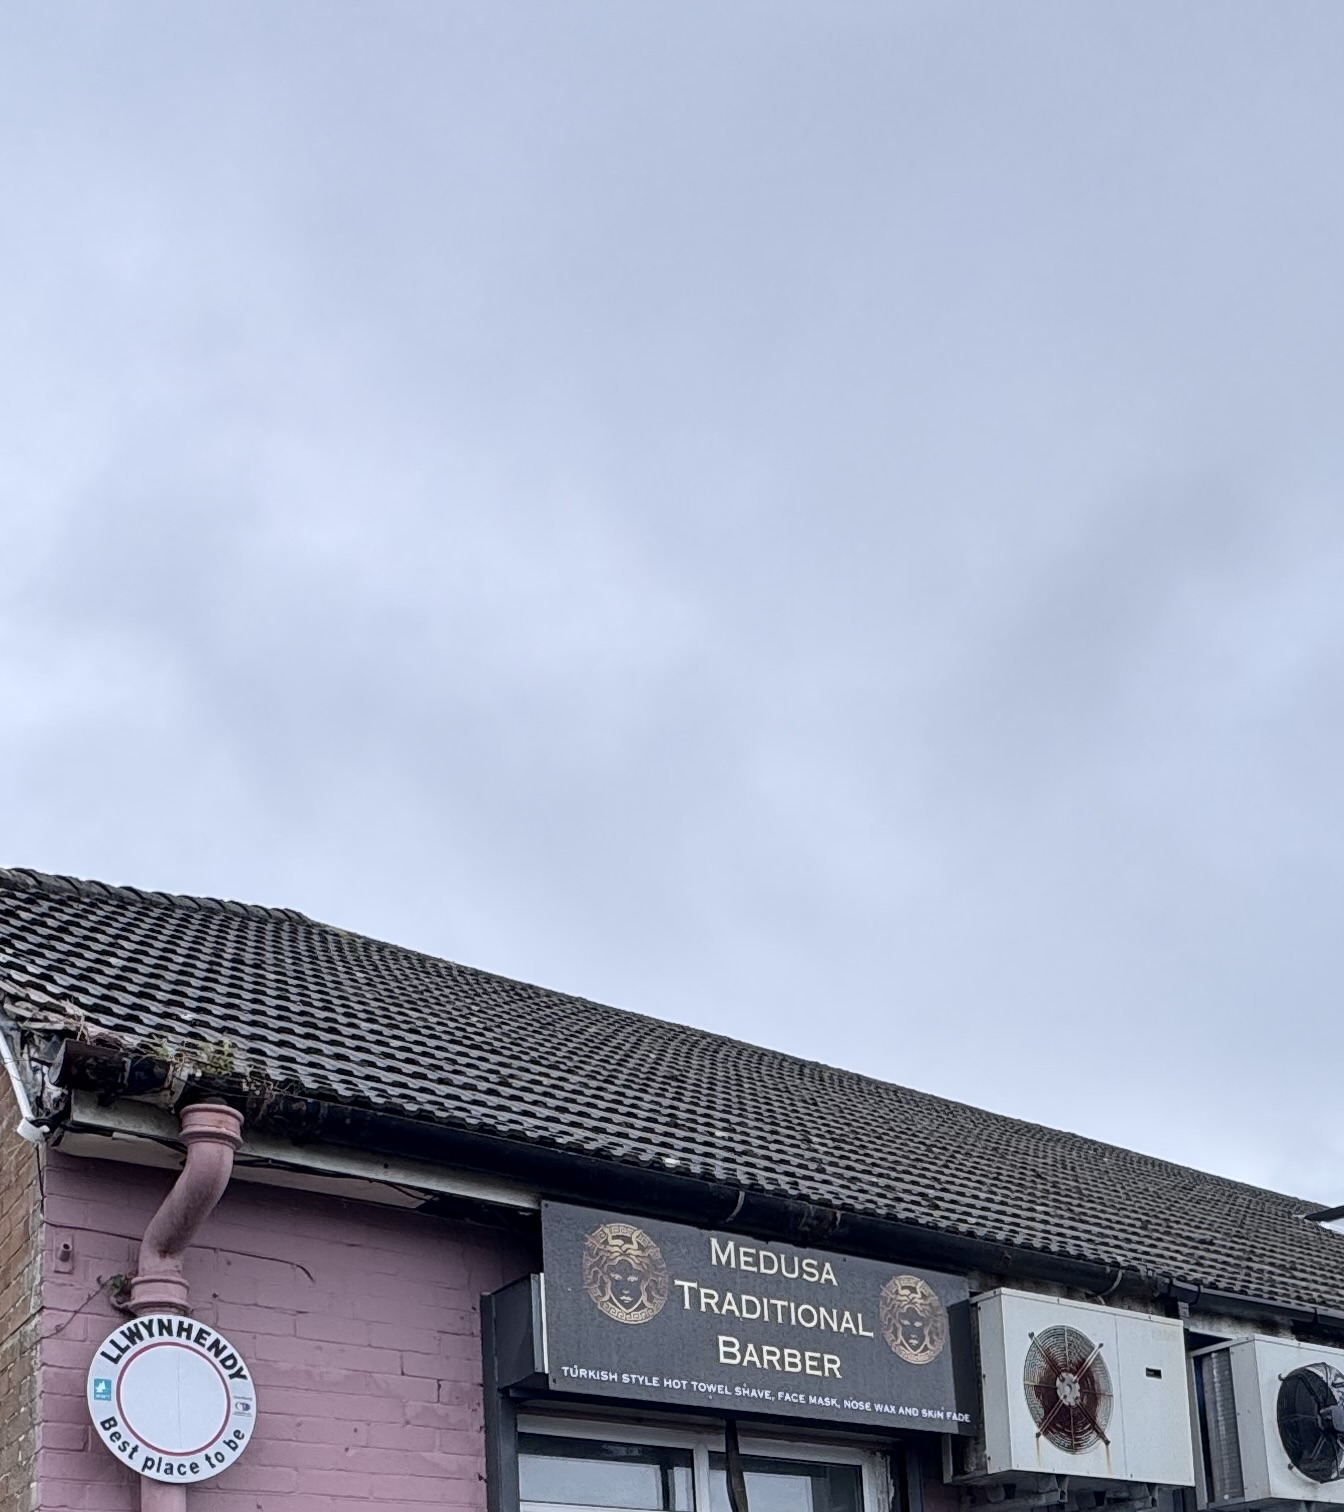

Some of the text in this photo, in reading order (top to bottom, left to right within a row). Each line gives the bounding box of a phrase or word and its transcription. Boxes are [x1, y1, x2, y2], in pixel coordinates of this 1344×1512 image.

[710, 1237, 837, 1286] MEDUSA
[674, 1279, 874, 1339] TRADITIONAL
[100, 1318, 248, 1381] LLWYNHENDY
[717, 1335, 843, 1379] BARBER
[561, 1365, 972, 1424] TURKISH STYLE HOT TOWEL SHAVE, FACE MASK, NOSE WAX AND SKIN FADE
[99, 1416, 246, 1476] Best place to be
